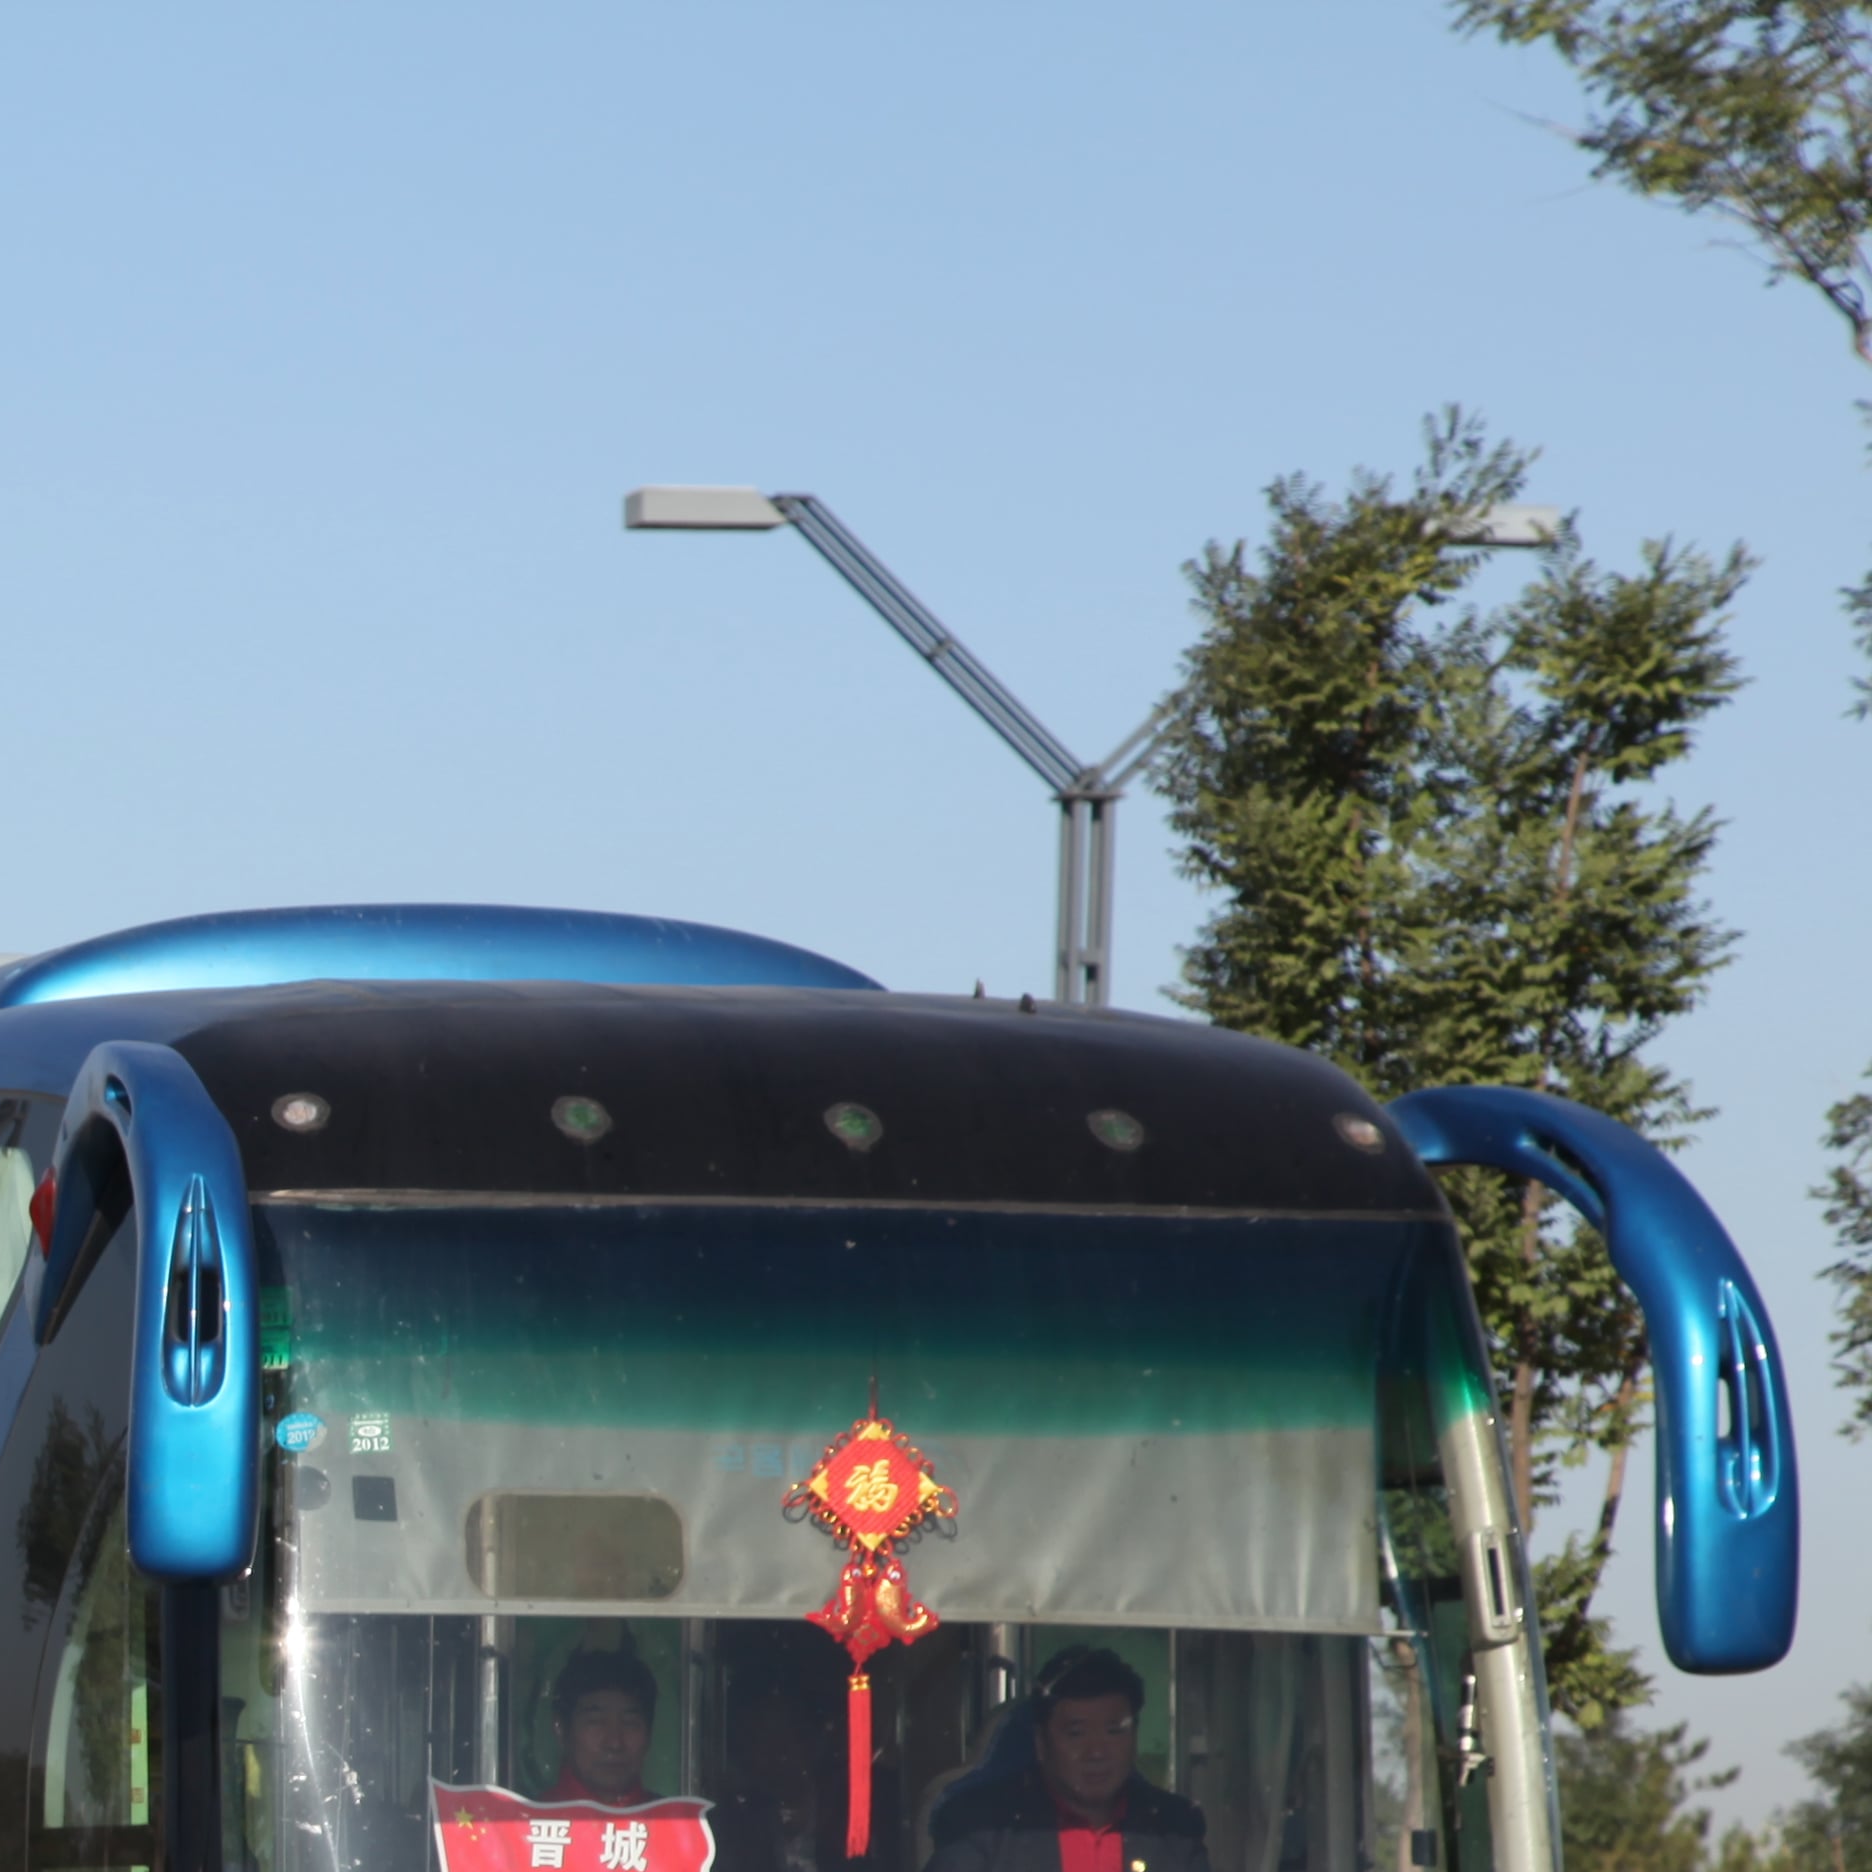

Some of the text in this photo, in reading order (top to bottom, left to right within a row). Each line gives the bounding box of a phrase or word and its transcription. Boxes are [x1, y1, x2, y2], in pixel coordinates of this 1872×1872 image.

[352, 1436, 391, 1452] 2012
[844, 1458, 899, 1513] 福
[526, 1818, 649, 1872] 晋城
